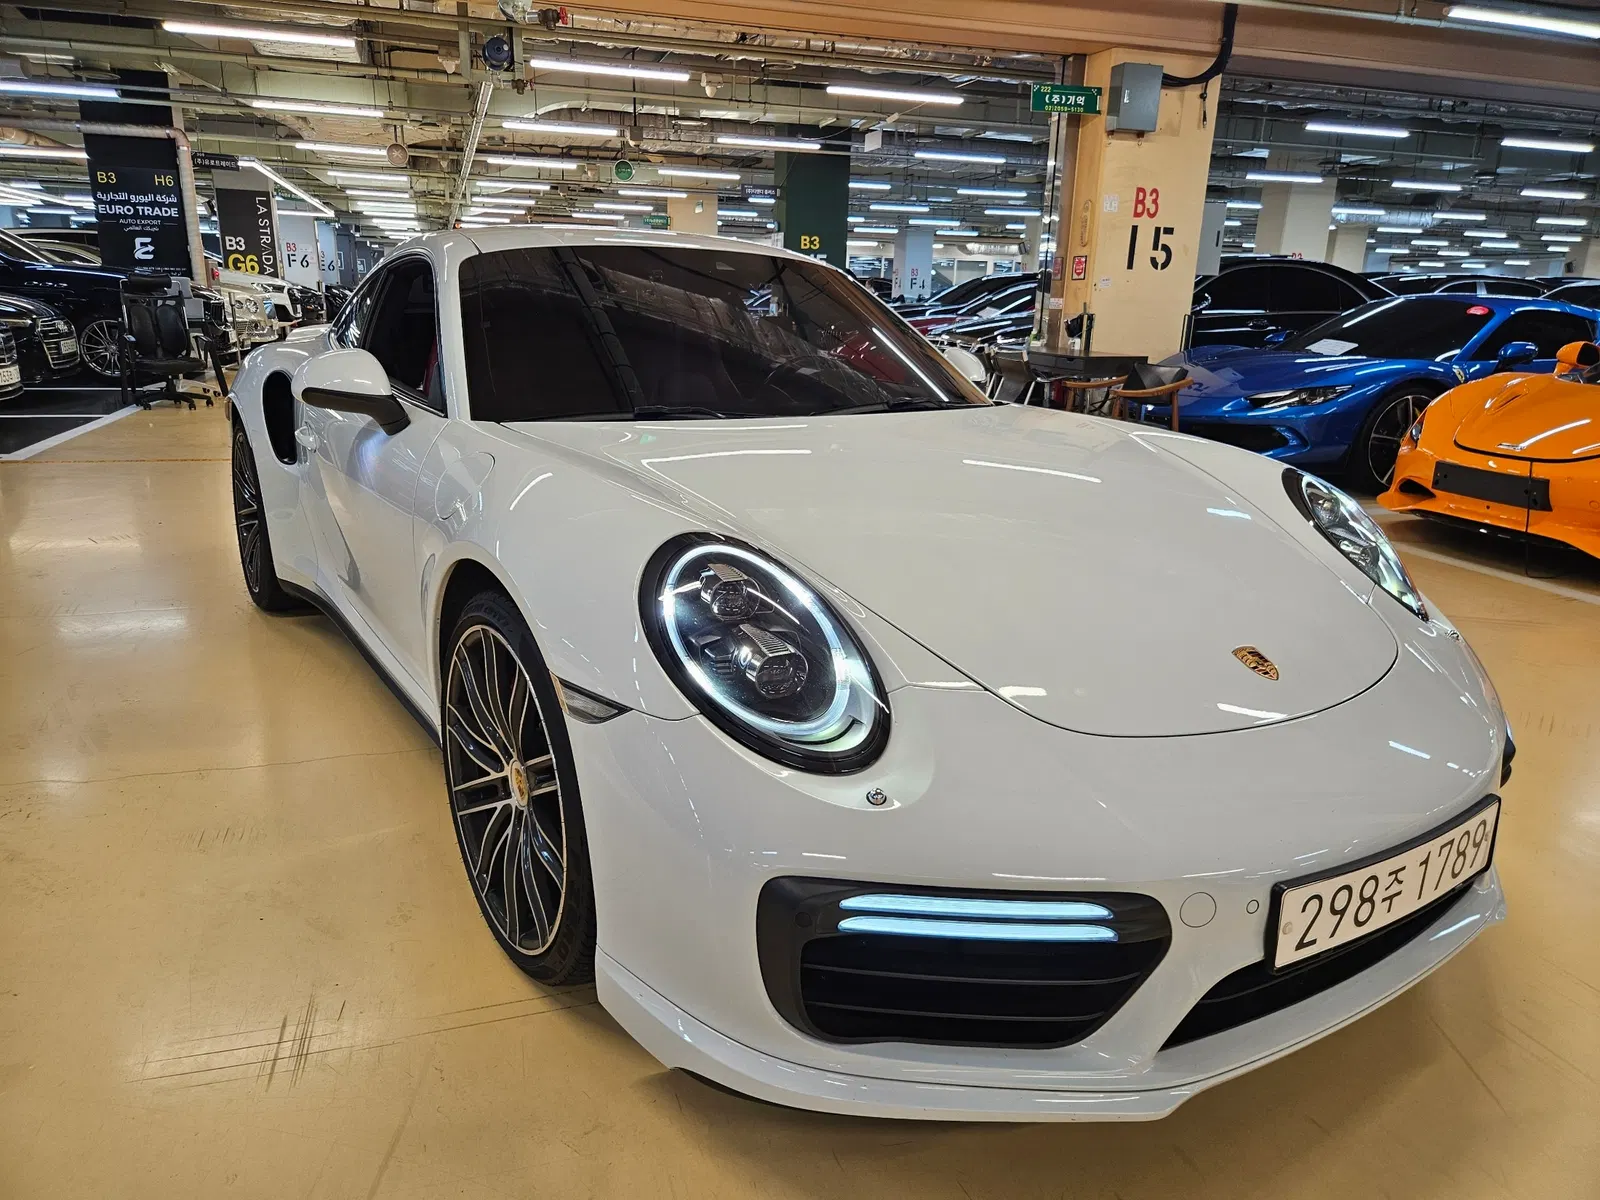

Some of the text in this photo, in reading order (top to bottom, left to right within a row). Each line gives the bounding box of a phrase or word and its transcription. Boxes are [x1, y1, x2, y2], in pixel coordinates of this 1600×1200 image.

[97, 171, 175, 187] B3 H6
[96, 191, 178, 204] شركة اليورو التجارية
[1132, 186, 1160, 219] B3
[98, 204, 179, 217] EURO TRADE
[255, 197, 268, 215] LA
[225, 236, 246, 251] B3
[286, 242, 297, 252] B3
[800, 235, 820, 250] B3
[228, 253, 260, 275] G6
[1294, 818, 1487, 951] 298주 1789
